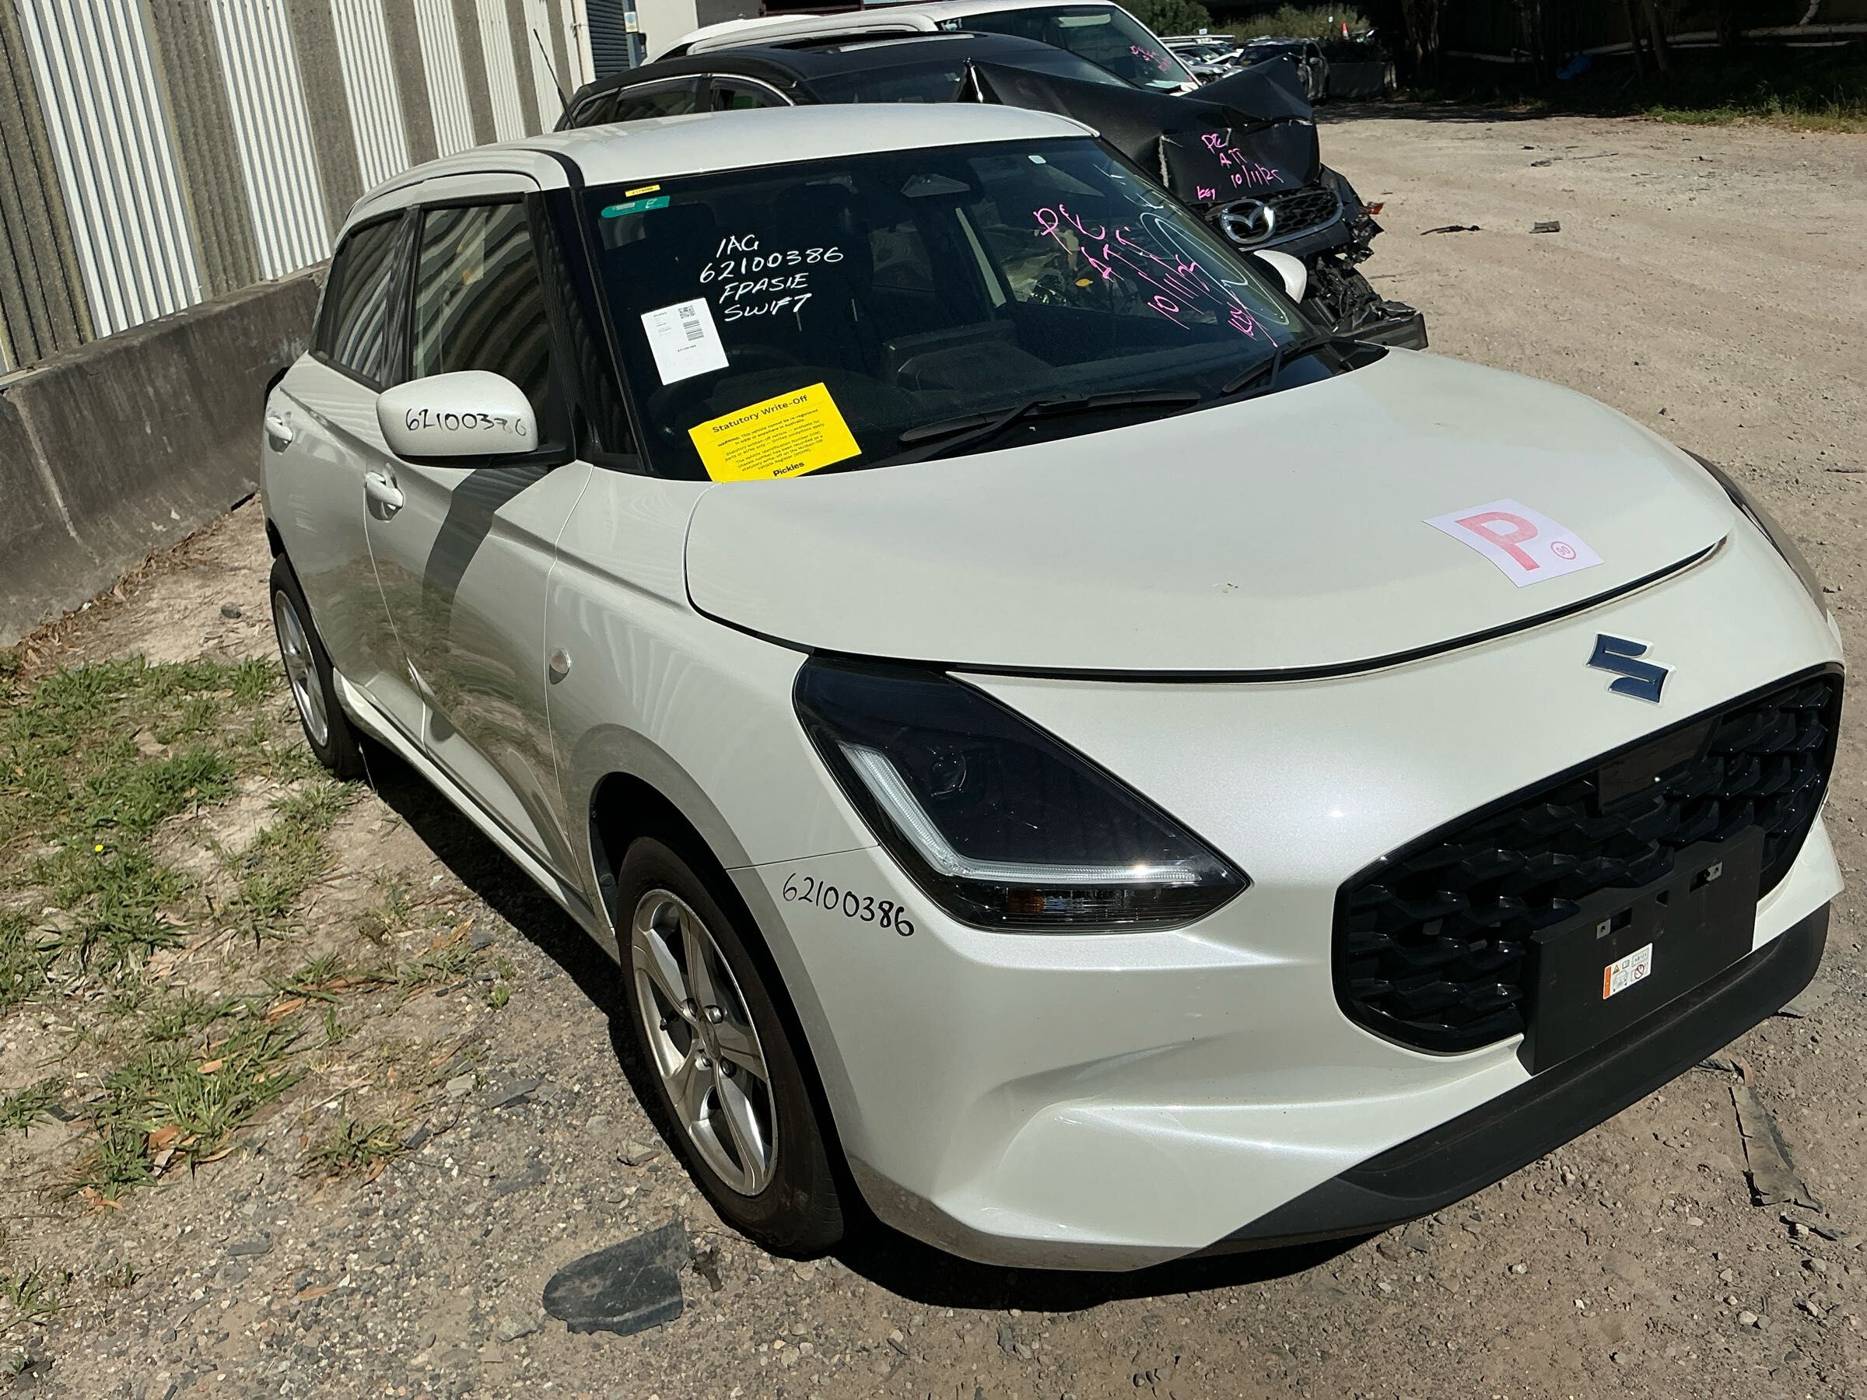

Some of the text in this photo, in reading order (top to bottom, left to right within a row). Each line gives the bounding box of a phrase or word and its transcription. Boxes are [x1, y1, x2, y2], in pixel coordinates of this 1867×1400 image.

[1230, 163, 1284, 189] 10/11/25
[716, 234, 760, 259] IAG
[699, 246, 844, 283] 62100386
[723, 292, 813, 322] SWIFT
[712, 394, 809, 433] Statutory Write-Off
[772, 461, 805, 477] Pickles
[1455, 511, 1541, 571] P
[782, 872, 915, 937] 62100386
